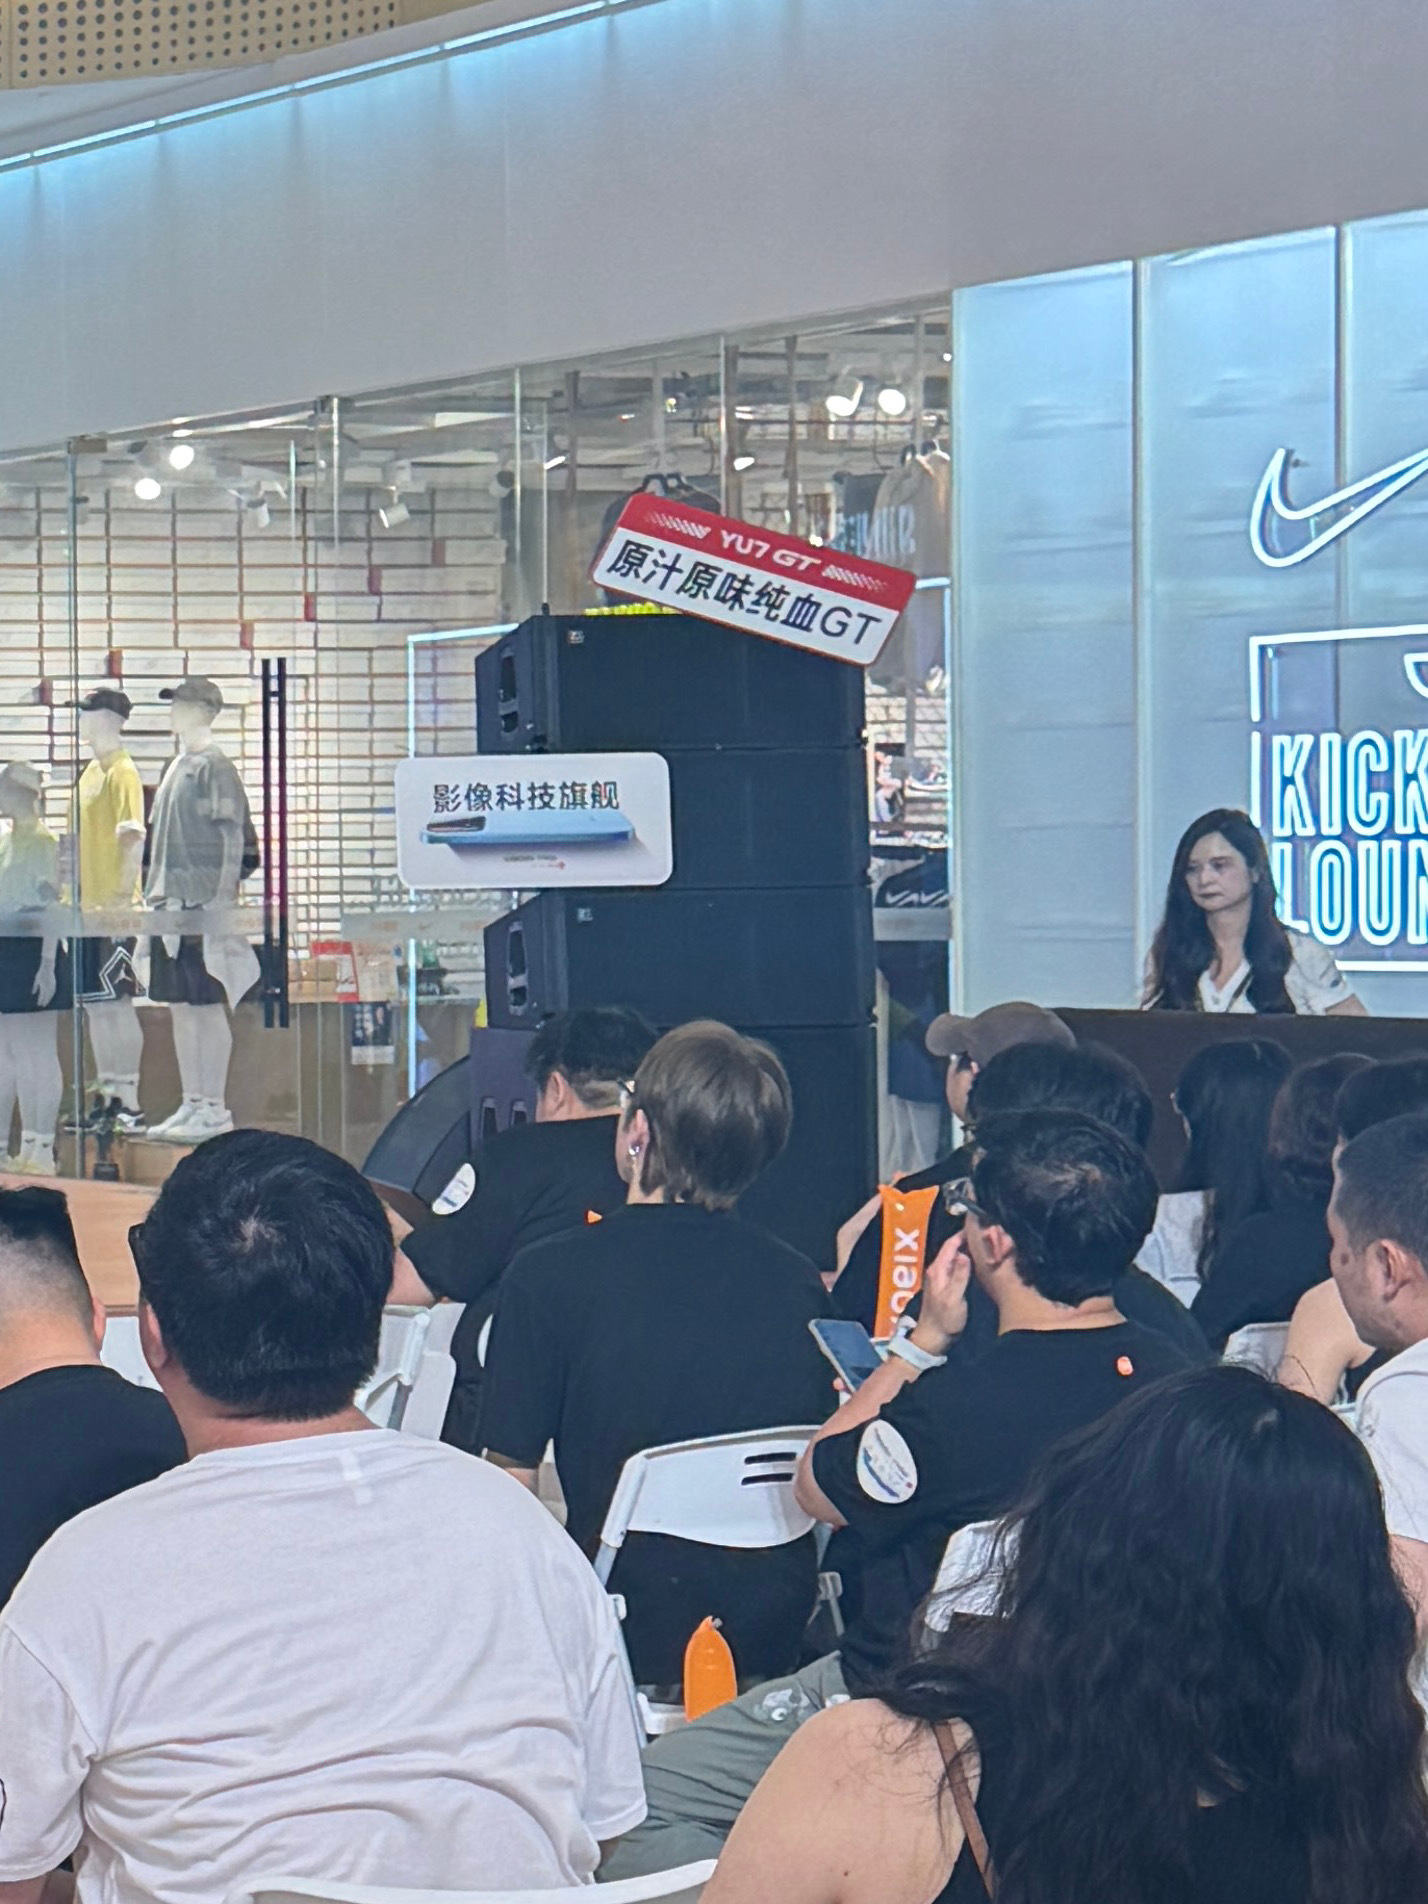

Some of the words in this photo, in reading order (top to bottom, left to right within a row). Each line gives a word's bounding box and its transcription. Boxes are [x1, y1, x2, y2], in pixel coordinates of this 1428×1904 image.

[720, 530, 771, 558] YU7
[772, 548, 822, 572] GT
[606, 539, 883, 646] 原汁原味纯血GT
[432, 780, 620, 814] 影像科技旗舰
[890, 1227, 919, 1324] xiao
